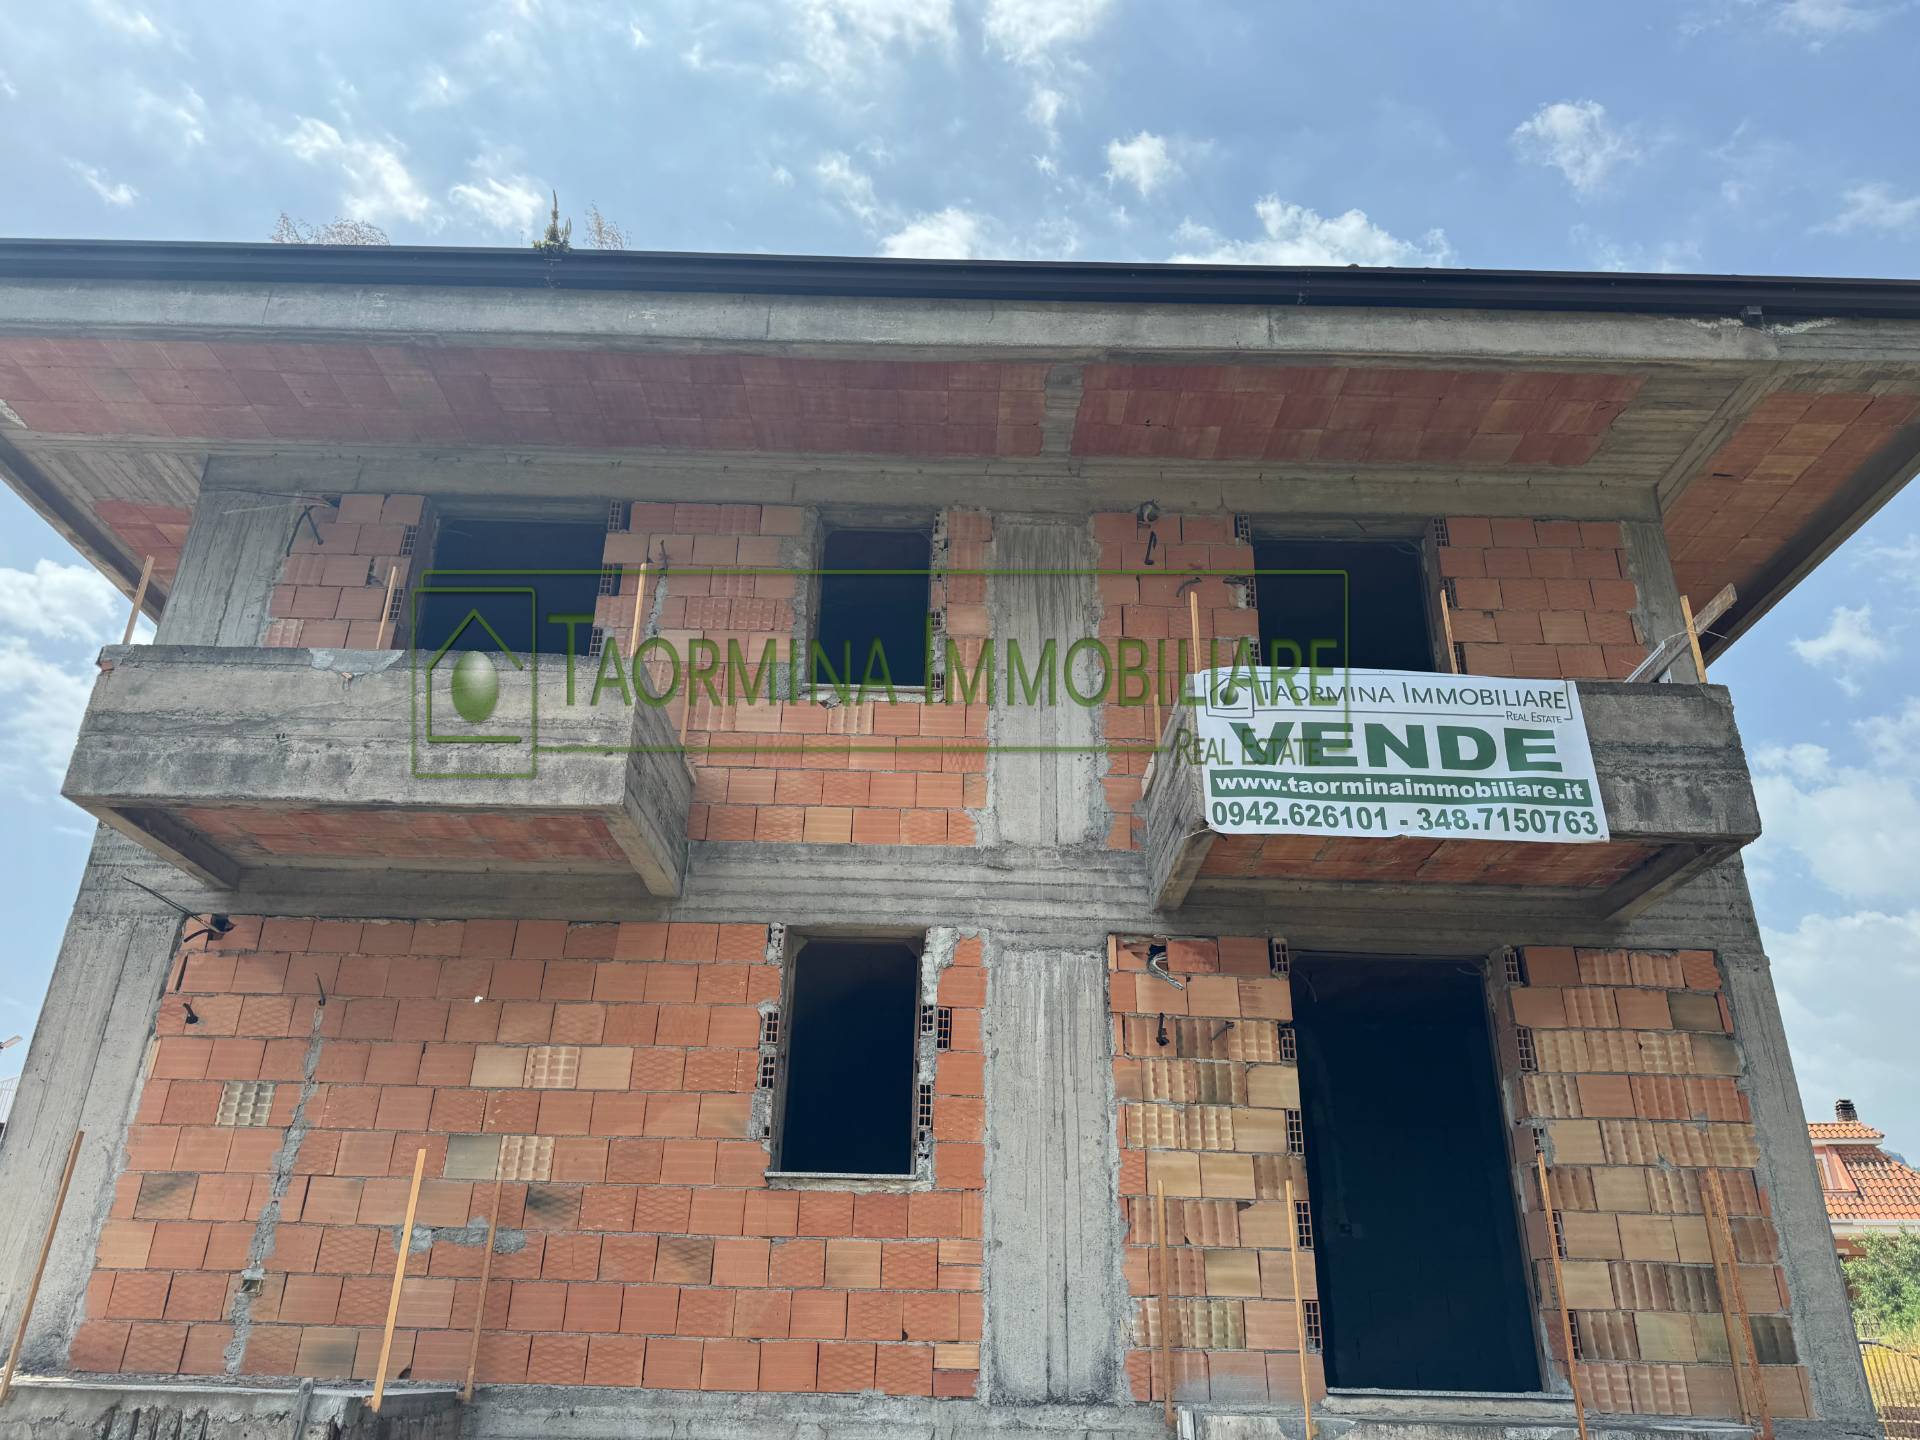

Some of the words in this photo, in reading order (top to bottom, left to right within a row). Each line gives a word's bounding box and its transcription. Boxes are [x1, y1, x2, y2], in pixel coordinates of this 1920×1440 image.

[1255, 680, 1395, 704] TAORMINA
[1402, 682, 1567, 709] IMMOBILIARE
[1505, 711, 1530, 722] REAL
[1531, 712, 1563, 724] ESTATE
[1229, 721, 1563, 772] VENDE
[1216, 776, 1585, 801] www.taorminaimmobiliare.it
[1211, 801, 1388, 831] 0942.626101
[1416, 807, 1599, 835] 348.7150763
